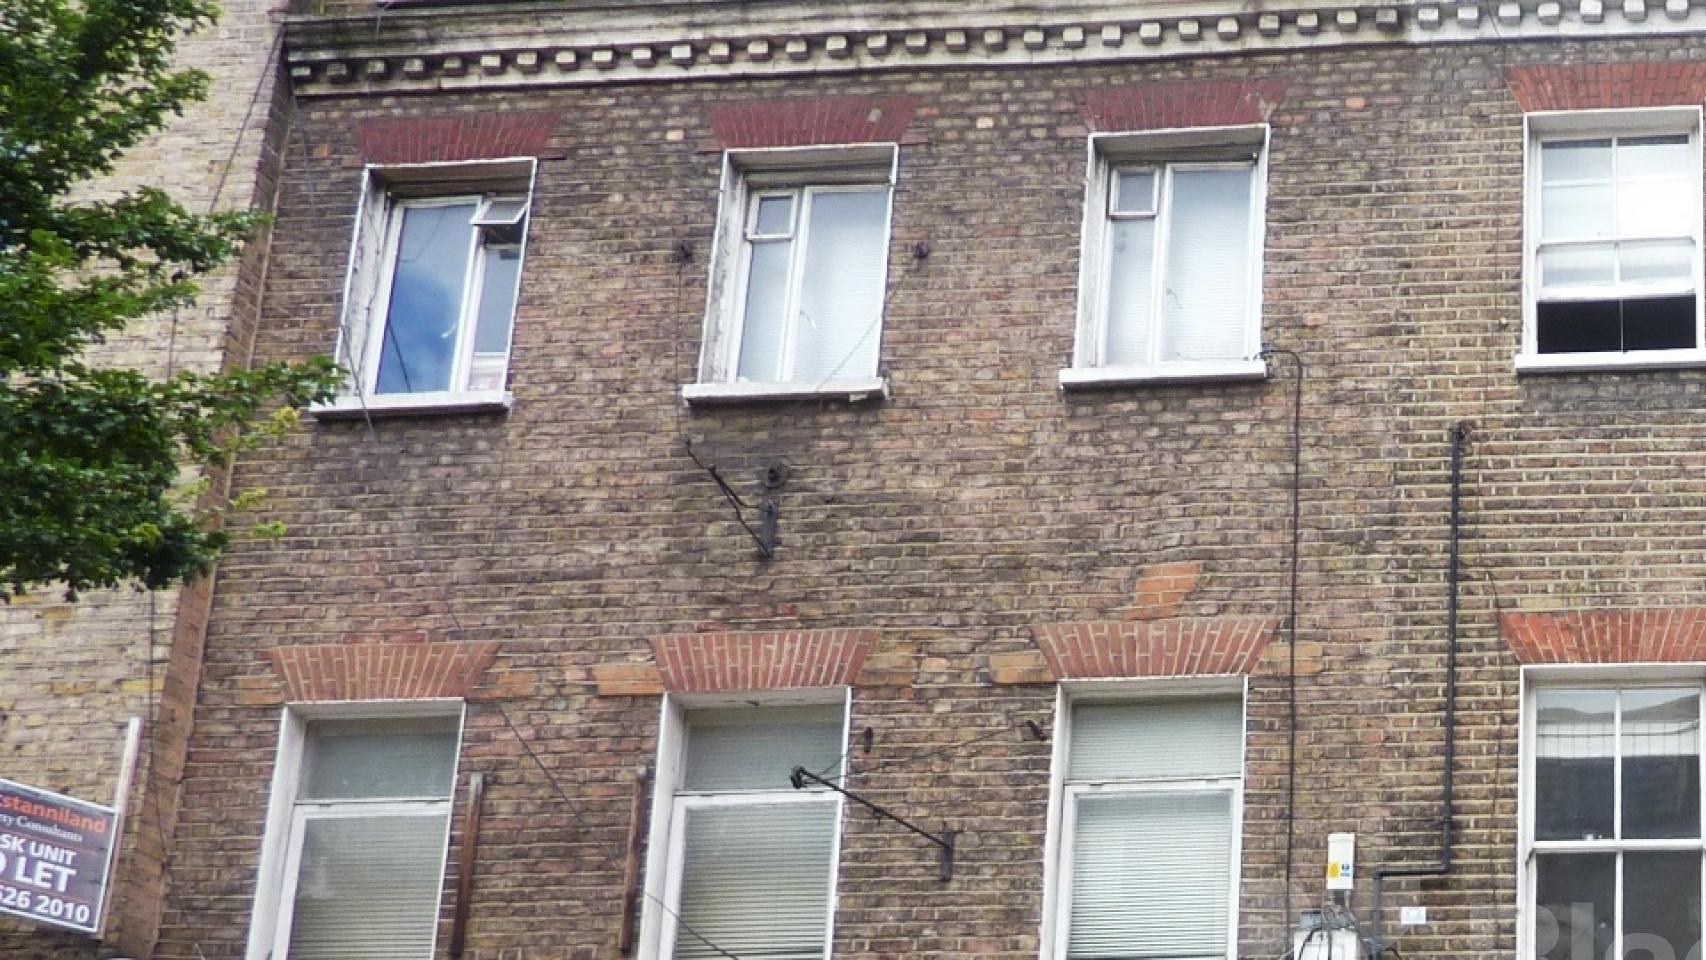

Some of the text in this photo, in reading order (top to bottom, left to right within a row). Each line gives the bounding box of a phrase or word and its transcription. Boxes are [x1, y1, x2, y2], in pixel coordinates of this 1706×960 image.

[0, 793, 107, 833] stanniland
[30, 840, 78, 865] UNIT
[15, 856, 77, 892] LET
[0, 885, 90, 922] 26 2010
